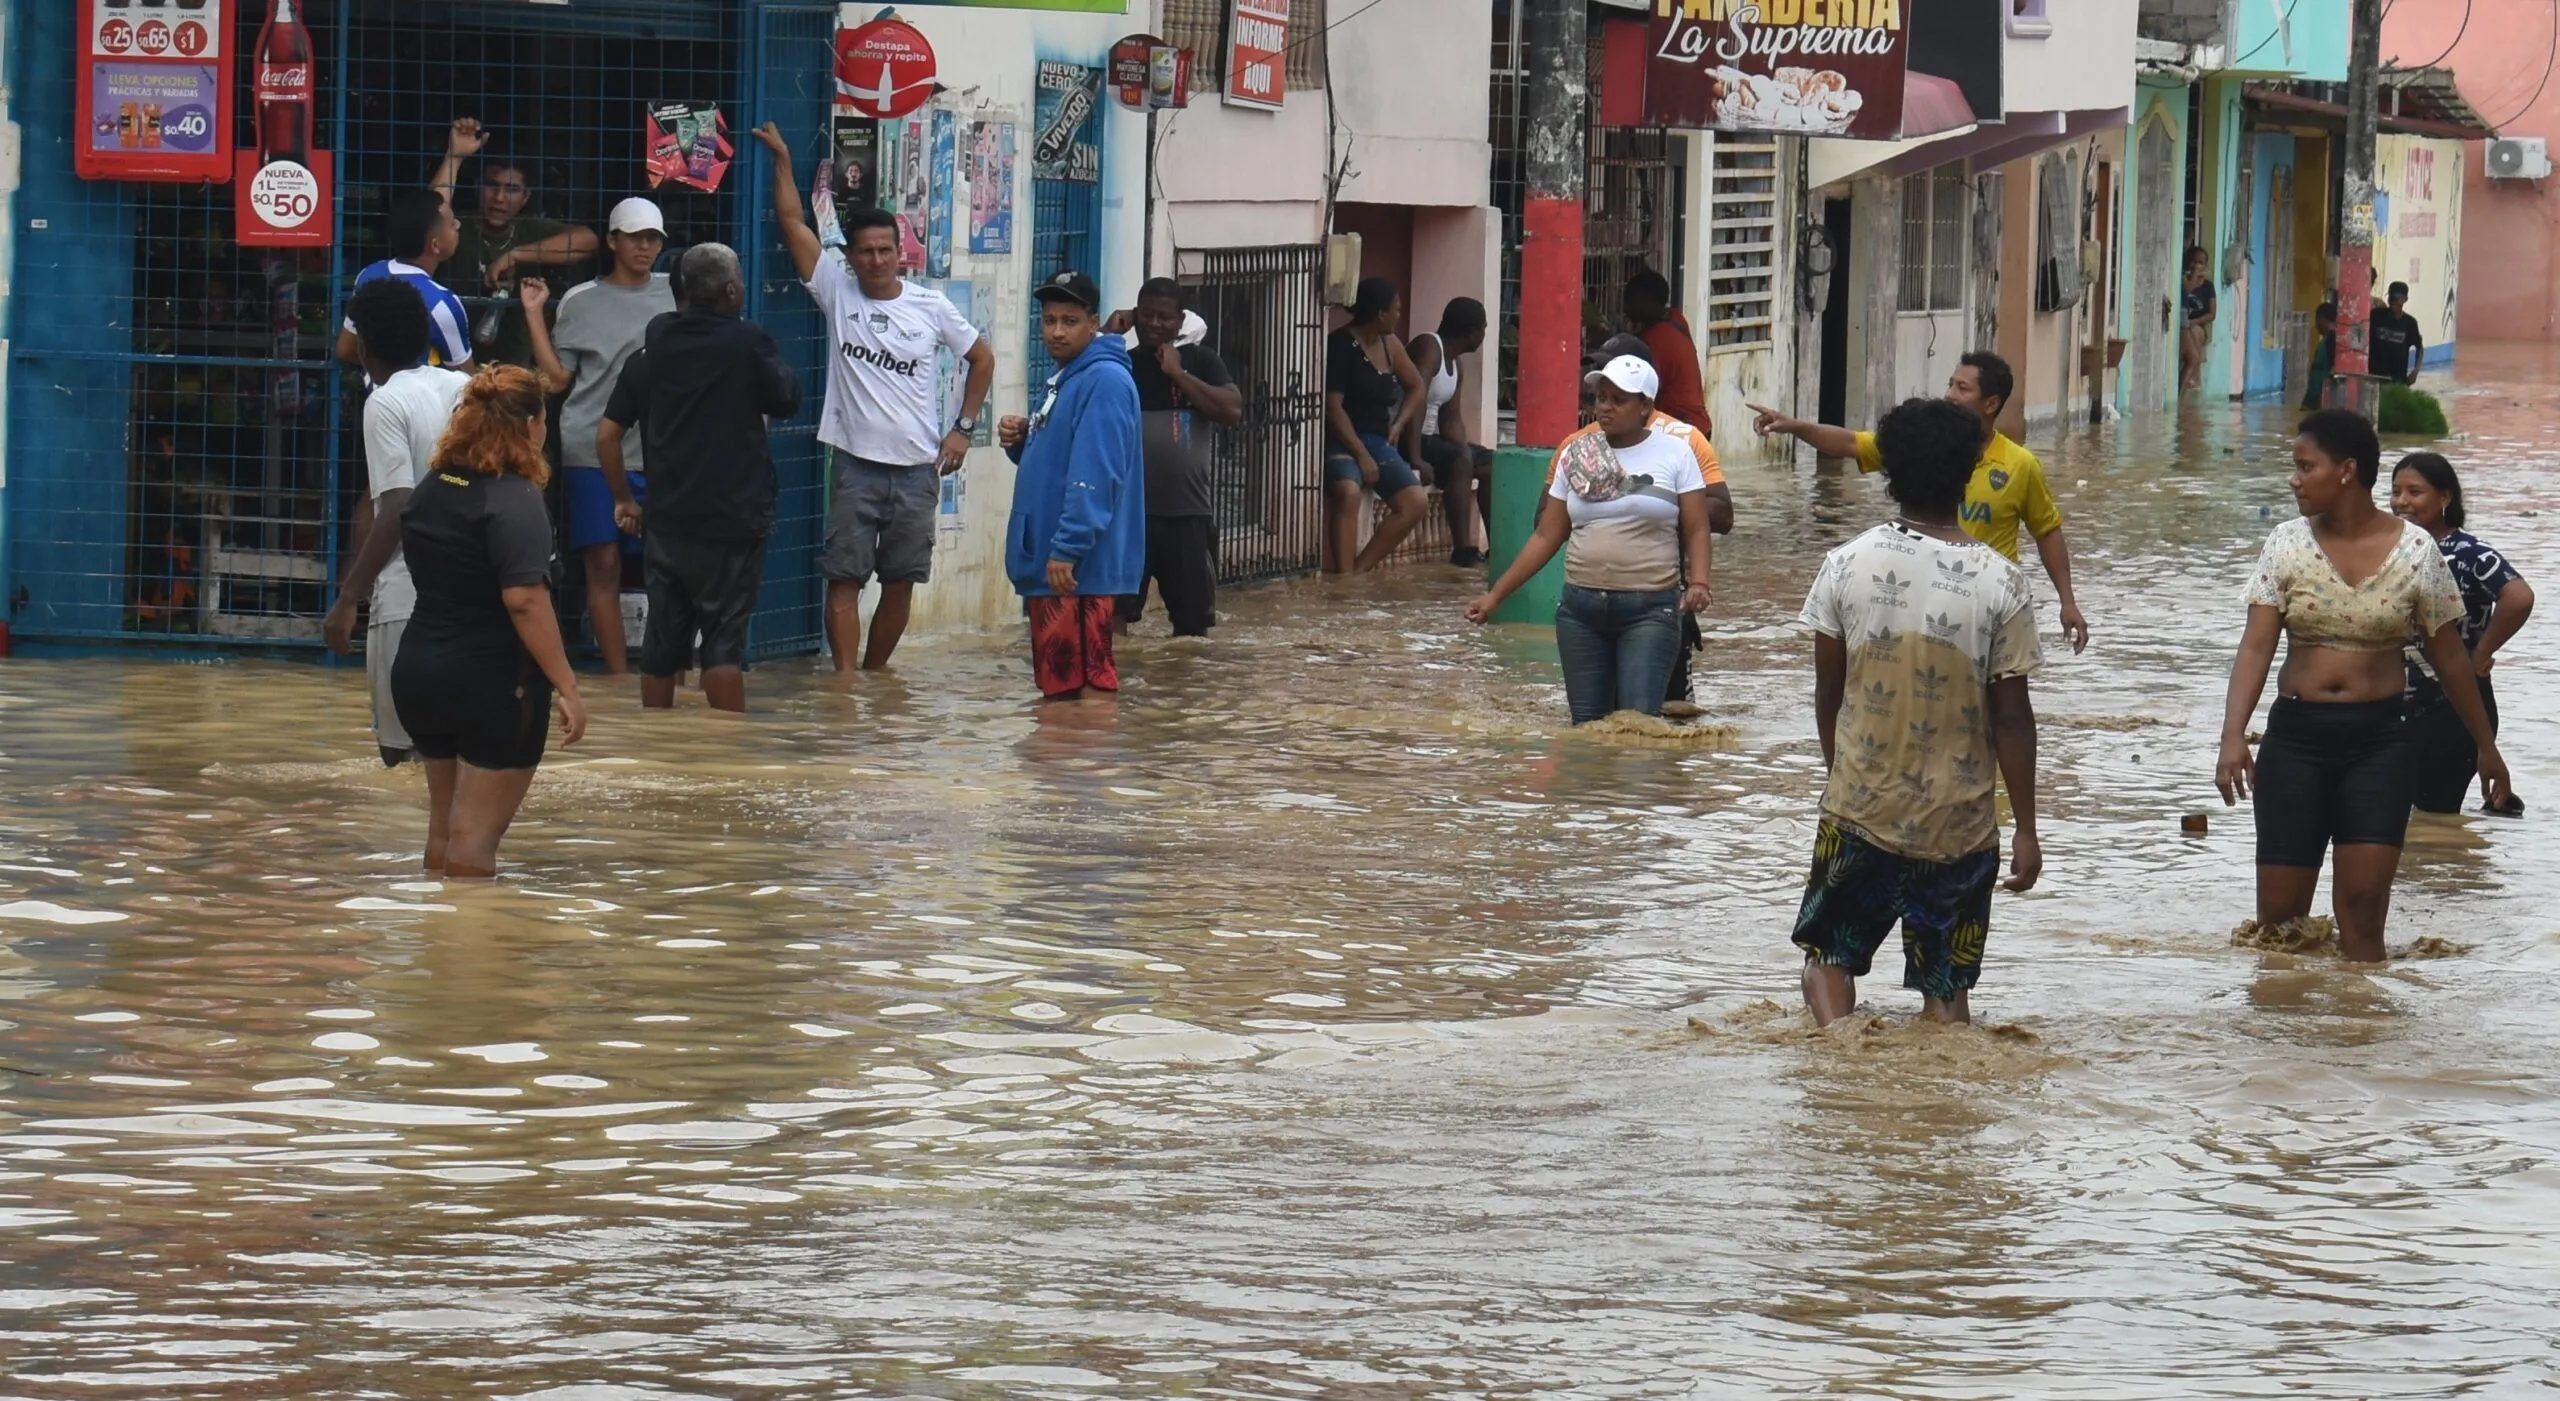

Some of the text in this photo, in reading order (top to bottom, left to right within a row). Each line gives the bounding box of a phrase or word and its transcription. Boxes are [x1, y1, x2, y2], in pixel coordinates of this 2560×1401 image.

[1236, 16, 1285, 54] INFORME
[1657, 5, 1896, 71] La Suprema
[865, 40, 911, 52] Destapa
[848, 49, 927, 62] ahorra y repite
[1041, 61, 1078, 77] NUEVO
[1243, 61, 1272, 95] AQUI
[109, 74, 199, 87] LLEVA OPCIONES
[1040, 73, 1072, 90] CERO
[154, 88, 161, 97] Y
[163, 88, 199, 98] VARIADAS
[164, 116, 207, 136] $0.40
[1072, 143, 1099, 170] SIN
[265, 169, 304, 179] NUEVA
[253, 193, 312, 218] $0.50
[842, 341, 918, 377] novibet
